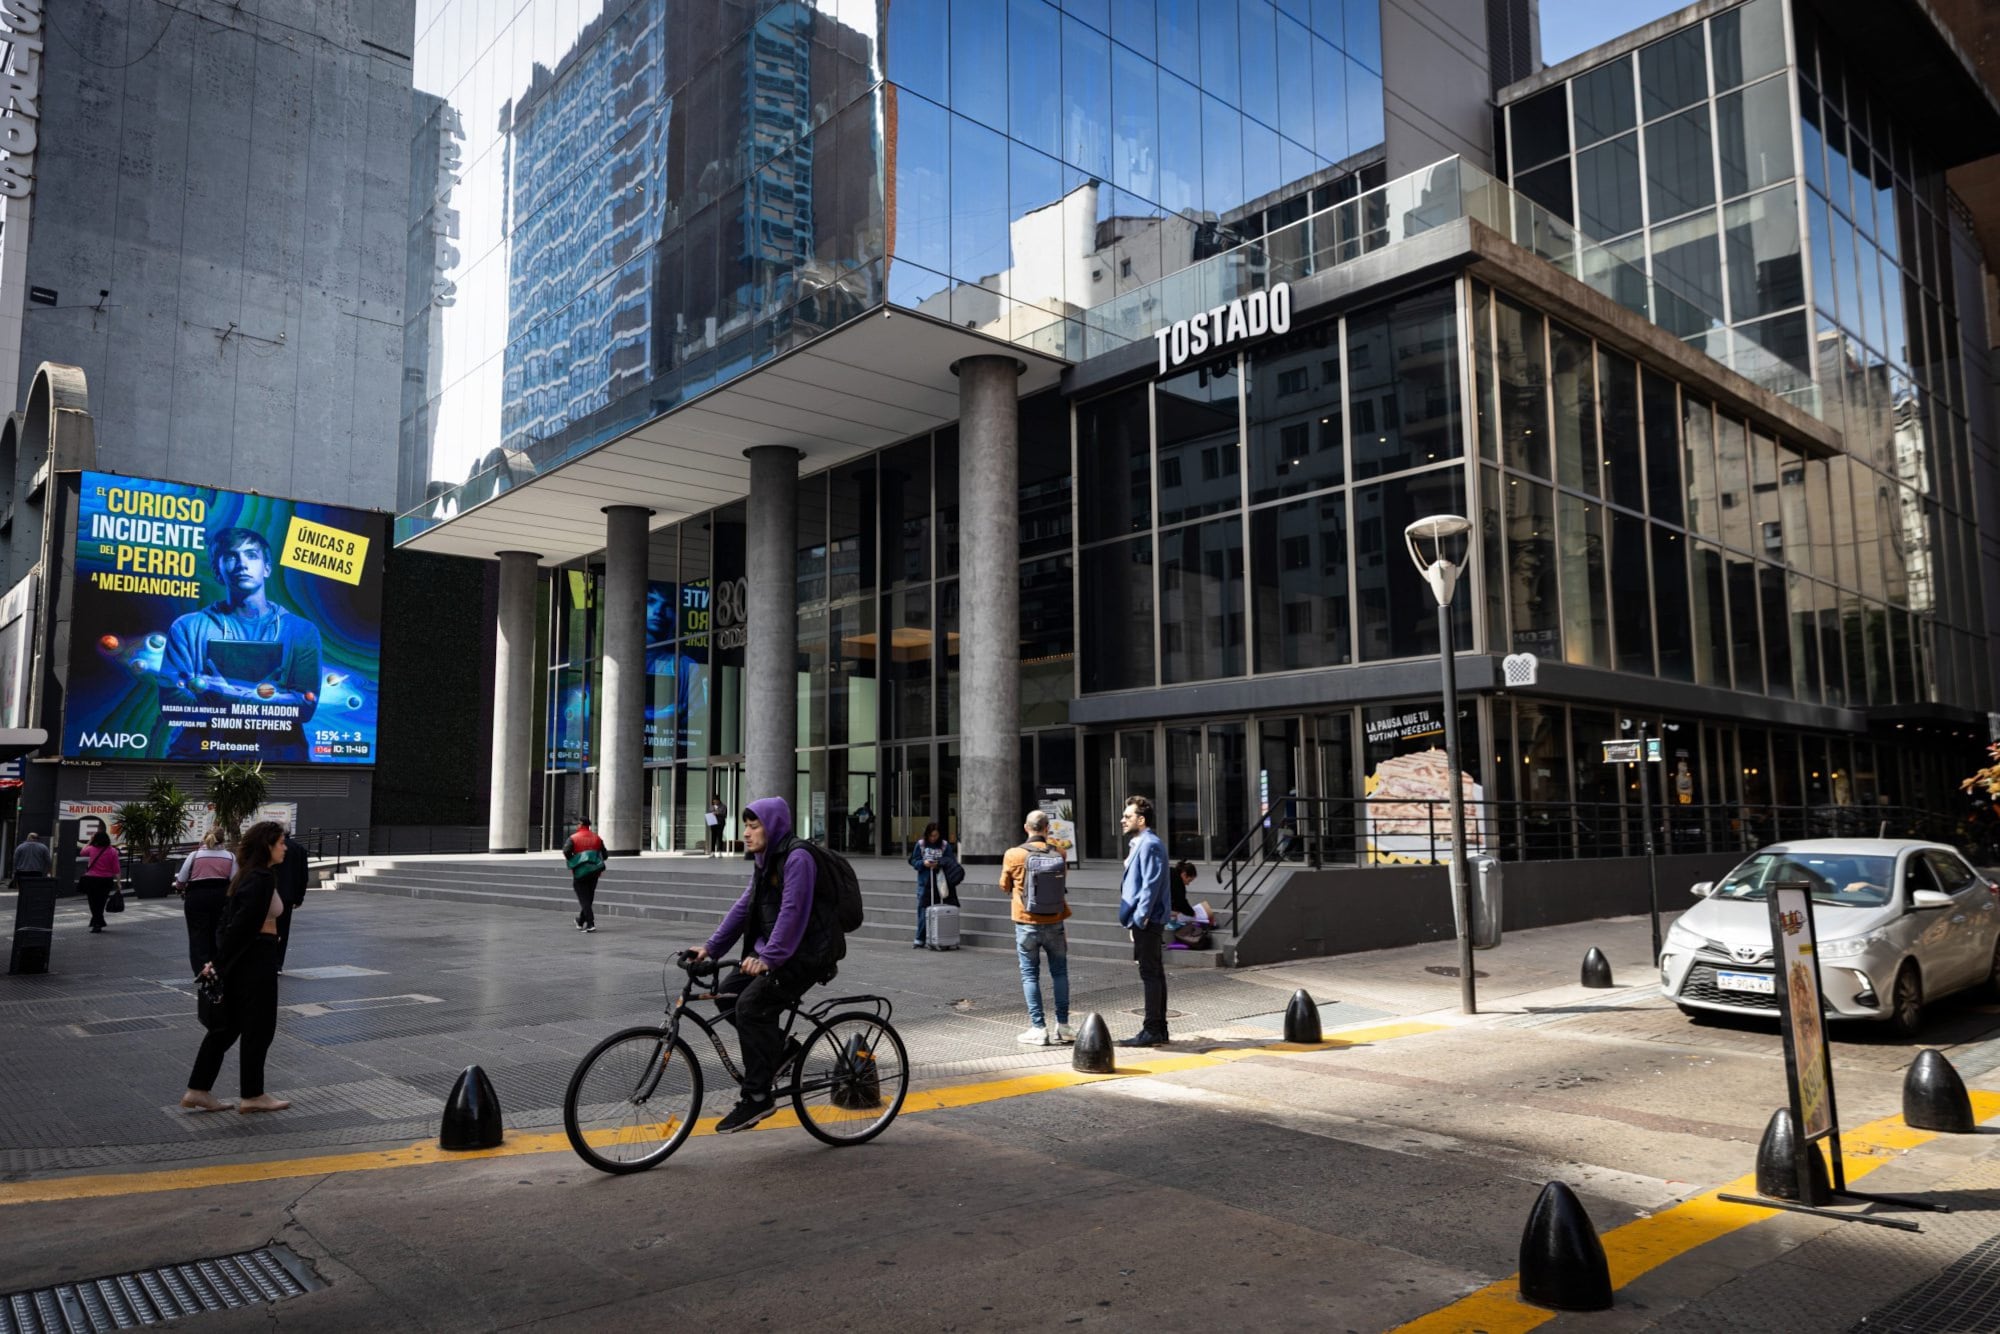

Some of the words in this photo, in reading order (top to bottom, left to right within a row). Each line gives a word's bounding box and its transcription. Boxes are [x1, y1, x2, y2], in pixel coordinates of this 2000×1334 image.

[1154, 282, 1291, 375] TOSTADO
[97, 487, 106, 496] EL
[108, 487, 205, 523] CURIOSO
[92, 514, 205, 550] INCIDENTE
[298, 526, 344, 553] ÚNICAS
[346, 542, 355, 556] 8
[100, 545, 115, 555] DEL
[117, 545, 196, 577] PERRO
[293, 547, 353, 575] SEMANAS
[91, 572, 98, 582] A
[99, 572, 201, 599] MEDIANOCHE
[231, 704, 259, 715] MARK
[261, 706, 299, 717] HADDON
[211, 718, 242, 729] SIMON
[244, 719, 292, 731] STEPHENS
[1366, 722, 1376, 733] LA
[1377, 717, 1402, 730] PAUSA
[1402, 713, 1419, 725] QUE
[1418, 710, 1429, 722] TU
[79, 731, 148, 749] MAIPO
[315, 730, 339, 741] 15%
[354, 731, 361, 741] 3
[1368, 730, 1399, 743] RUTINA
[1401, 721, 1442, 736] NECESITA
[210, 741, 260, 751] Plateanet
[69, 805, 84, 813] HAY
